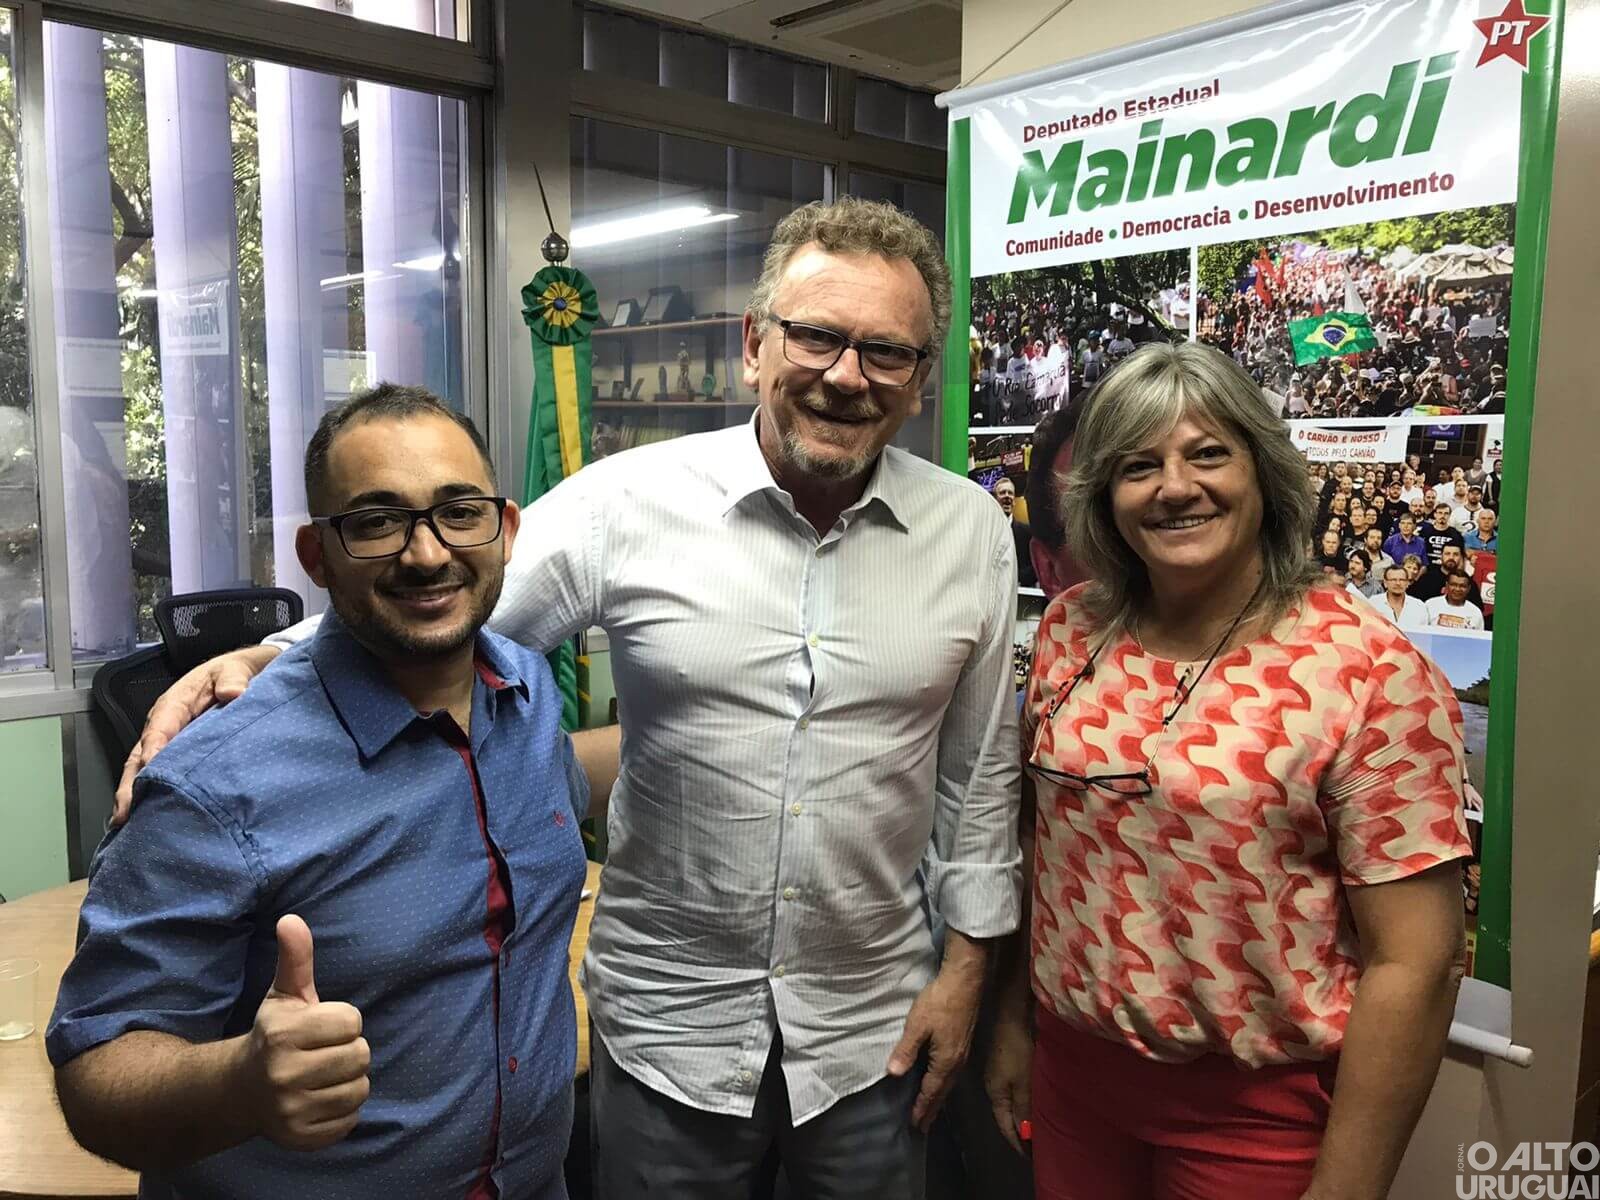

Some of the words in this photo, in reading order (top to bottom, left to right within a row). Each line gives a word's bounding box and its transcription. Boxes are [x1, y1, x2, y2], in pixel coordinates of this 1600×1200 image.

[1490, 19, 1530, 45] PT
[1007, 51, 1460, 225] Mainardi
[1023, 107, 1118, 143] Deputado
[1124, 80, 1220, 118] Estadual
[1005, 227, 1104, 257] Comunidade
[1122, 206, 1231, 240] Democracia
[1254, 170, 1455, 221] Desenvolvimento
[1351, 432, 1380, 443] NOSSO
